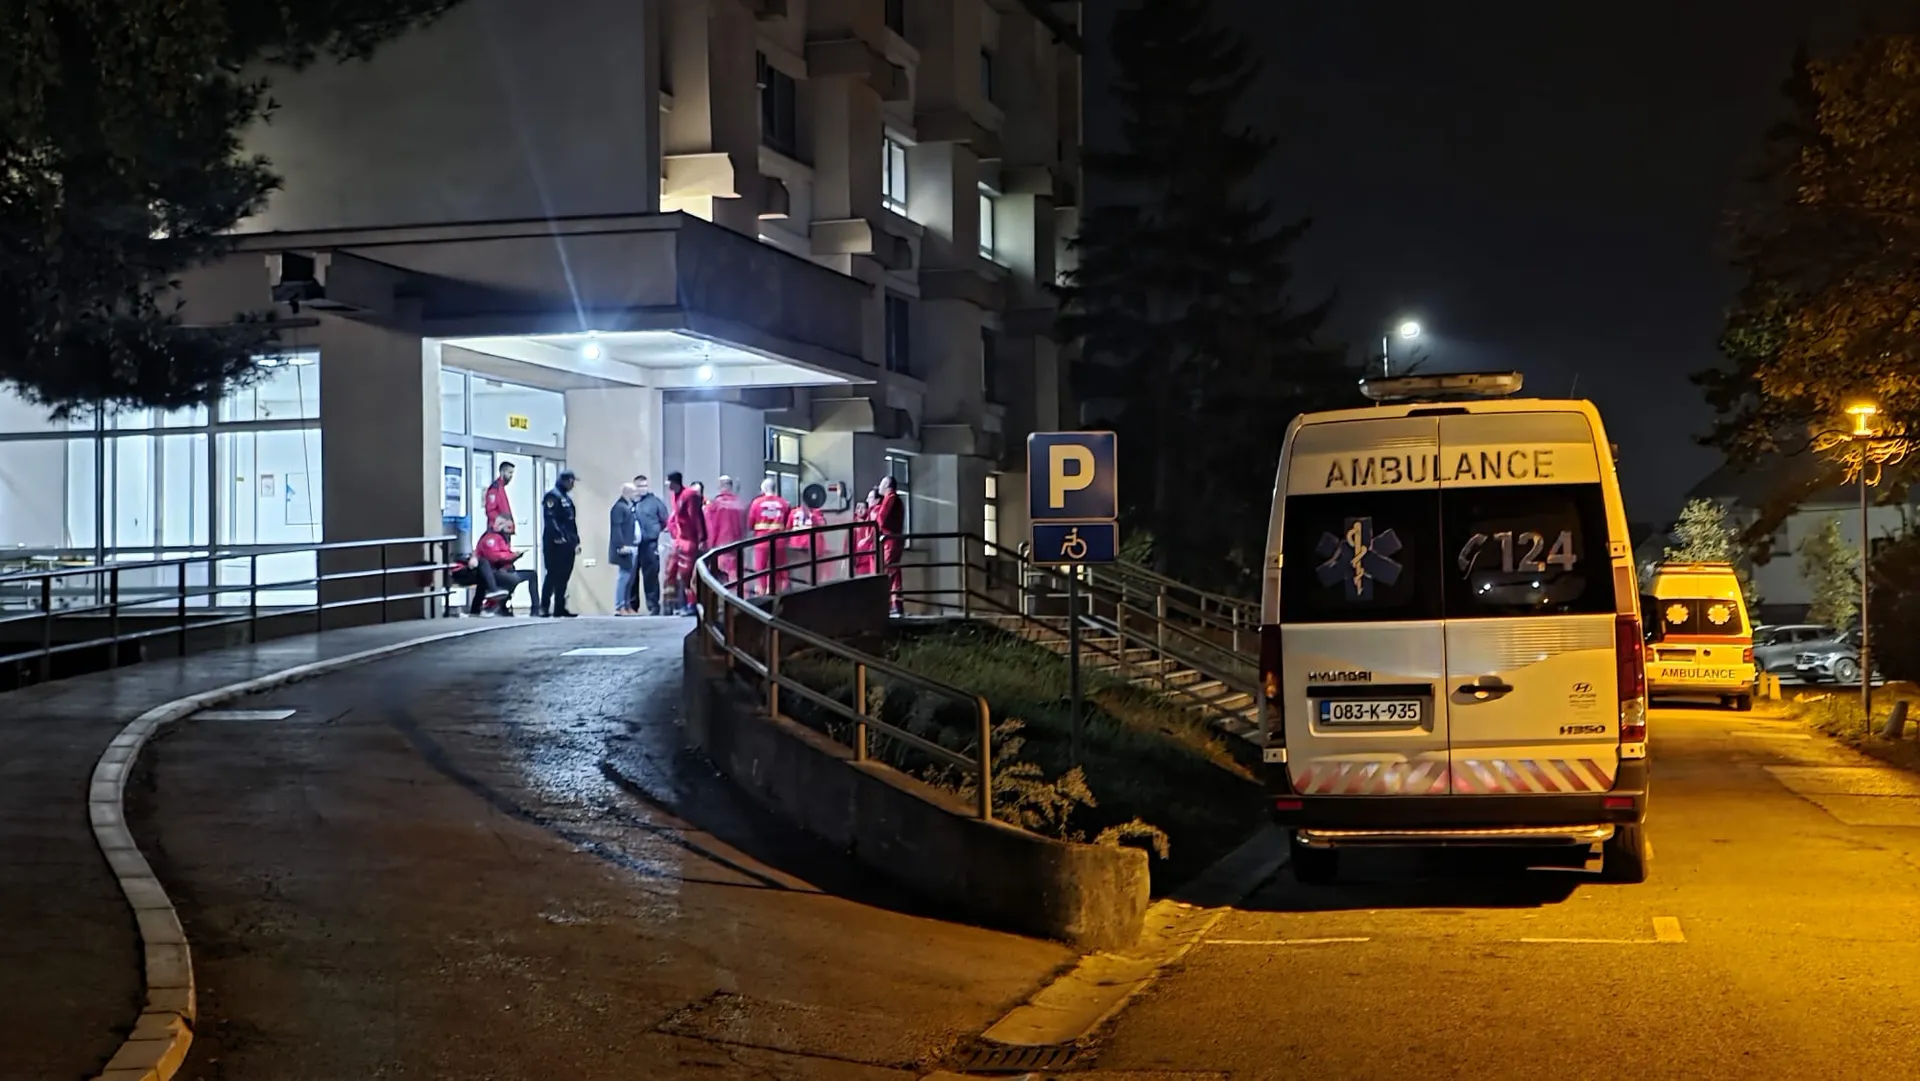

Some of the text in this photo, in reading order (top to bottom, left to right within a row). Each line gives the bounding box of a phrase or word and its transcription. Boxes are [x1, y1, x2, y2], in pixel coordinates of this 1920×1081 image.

[1049, 444, 1095, 508] P
[1325, 450, 1555, 488] AMBULANCE
[1494, 530, 1578, 573] 124
[1308, 671, 1372, 682] HYUNDAI
[1661, 668, 1736, 679] AMBULANCE
[1333, 703, 1418, 720] 083-K-935
[1560, 725, 1606, 735] H350
